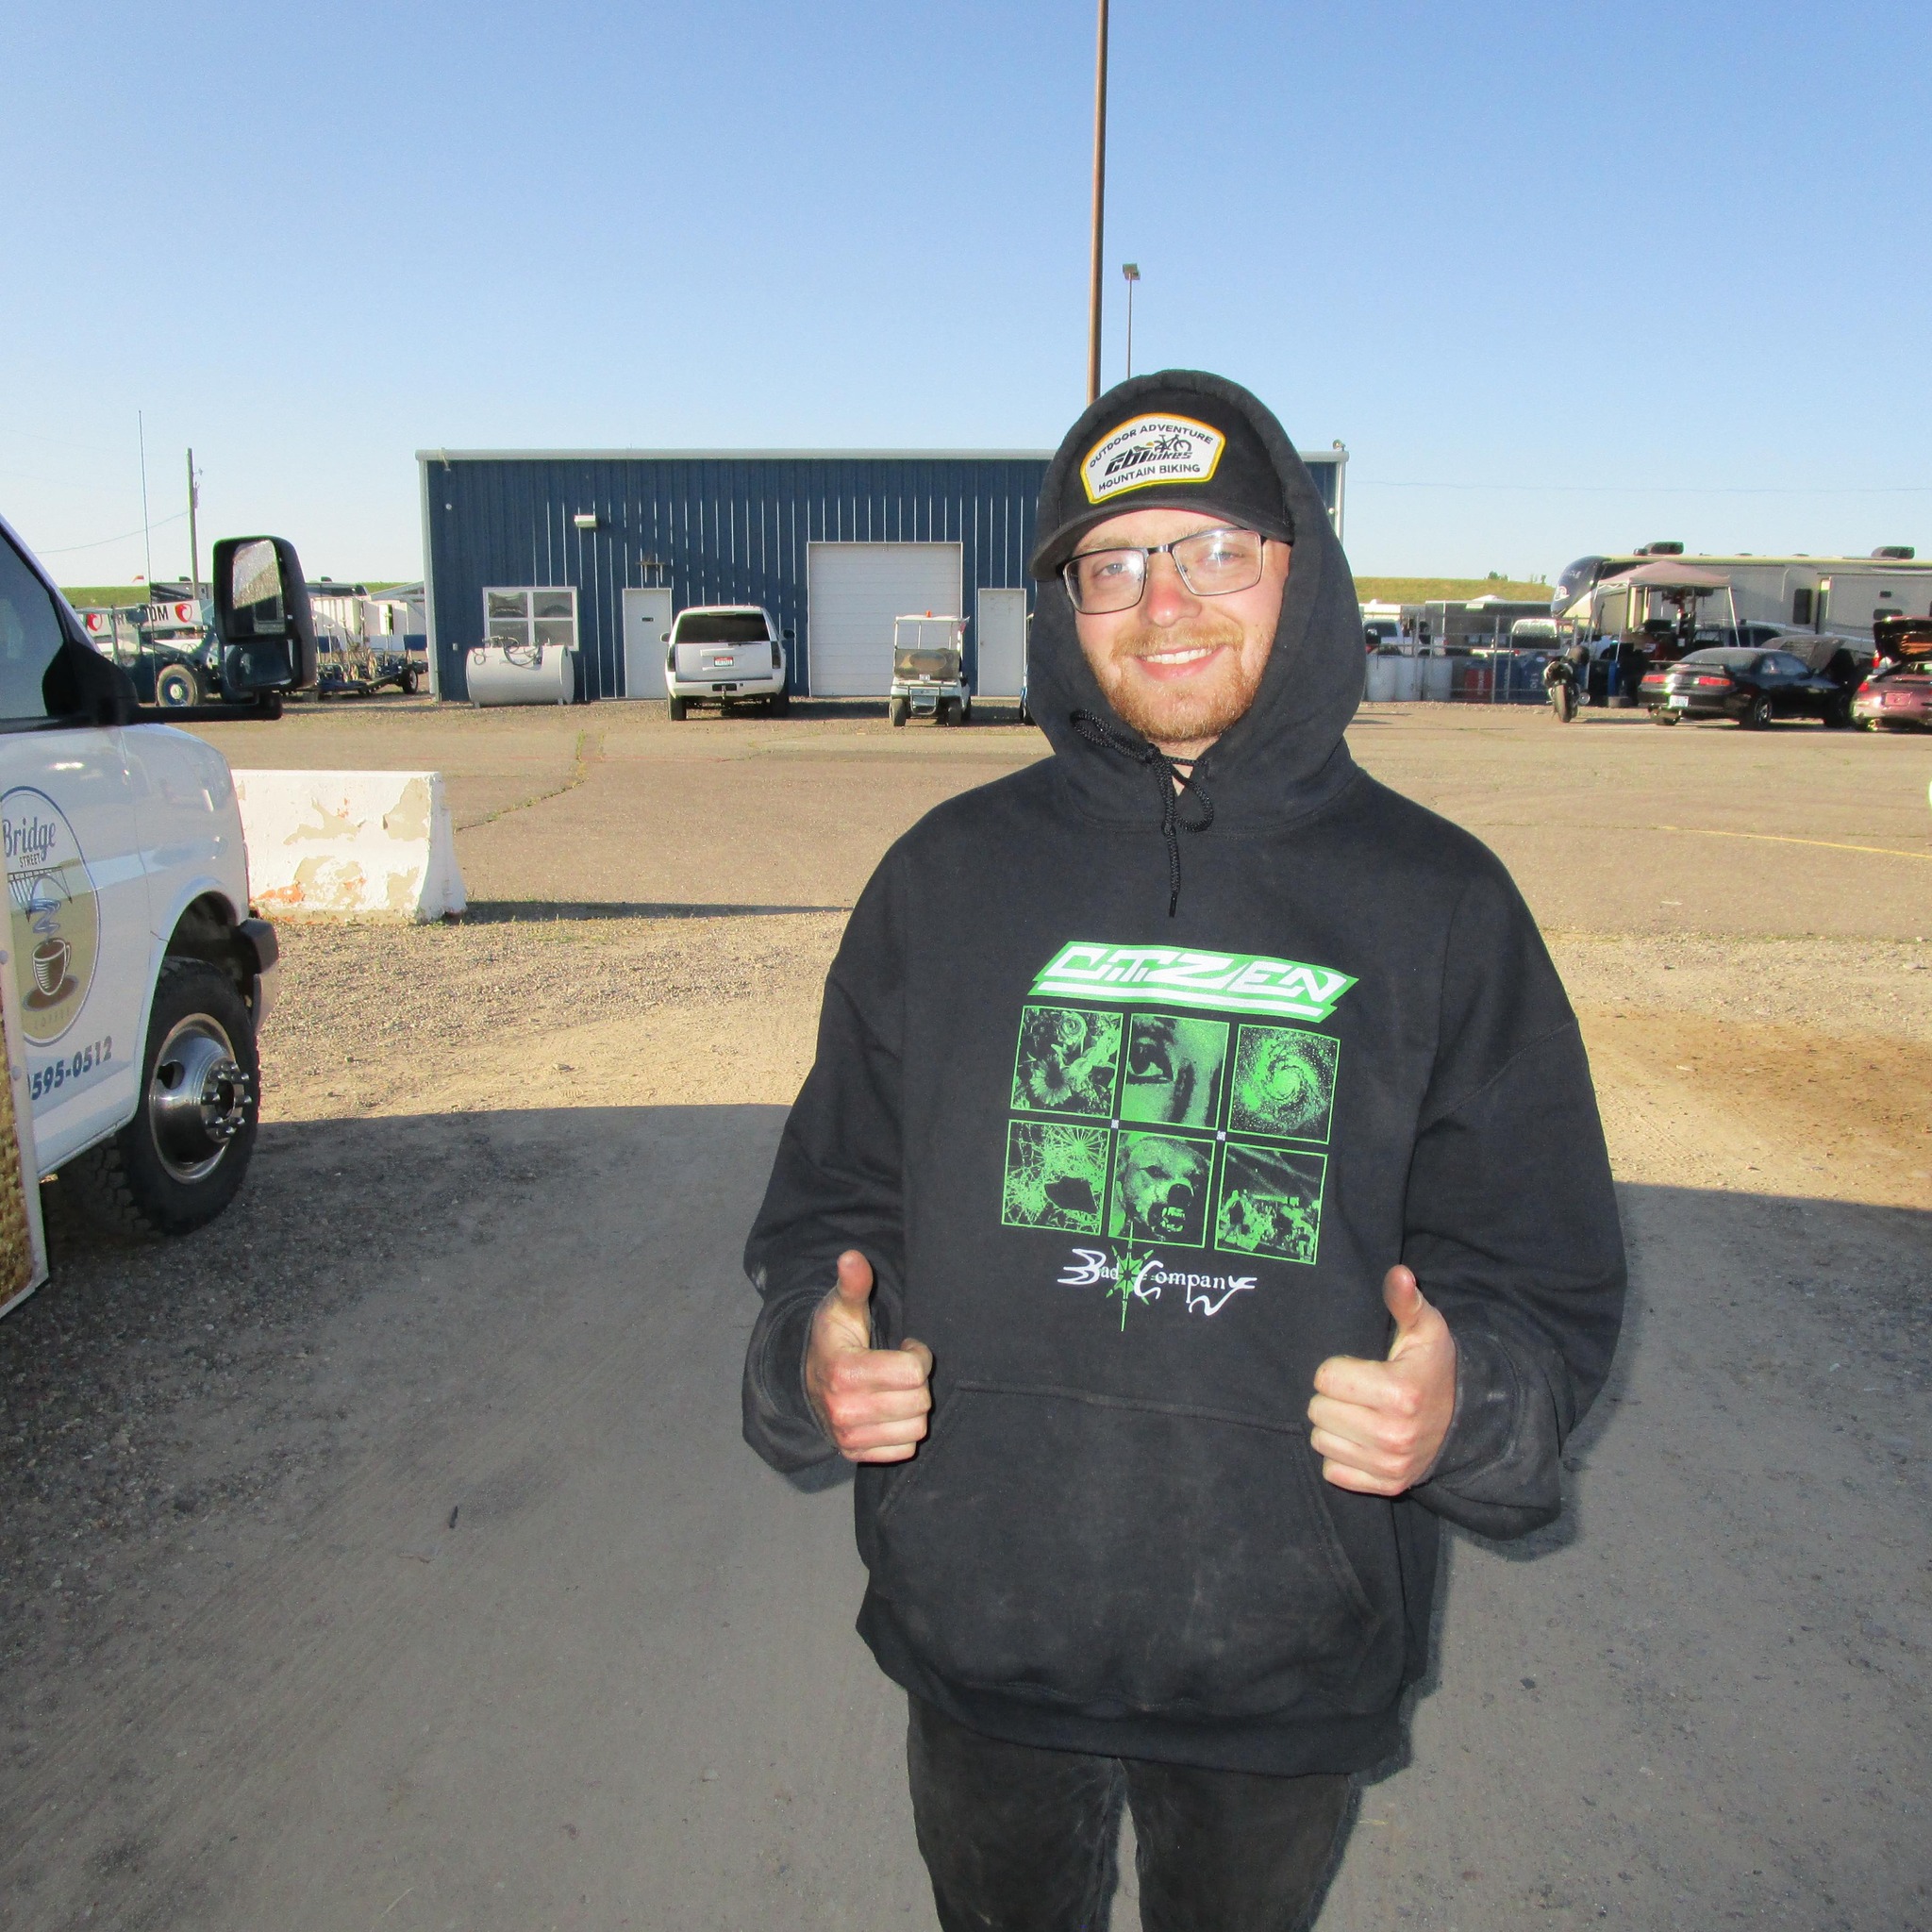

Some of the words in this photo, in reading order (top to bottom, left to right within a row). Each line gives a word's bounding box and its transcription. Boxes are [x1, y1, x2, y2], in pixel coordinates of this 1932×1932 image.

[1090, 428, 1137, 468] OUTDOOR
[1140, 424, 1214, 445] ADVENTURE
[1098, 465, 1156, 492] MOUNTAIN
[1159, 463, 1201, 475] BIKING
[2, 817, 57, 861] Bridge
[20, 853, 41, 868] STREET
[1043, 945, 1347, 1003] CITIZEN
[27, 1035, 112, 1101] 595-0512
[1057, 1248, 1121, 1285] Bad
[1133, 1259, 1258, 1317] Company
